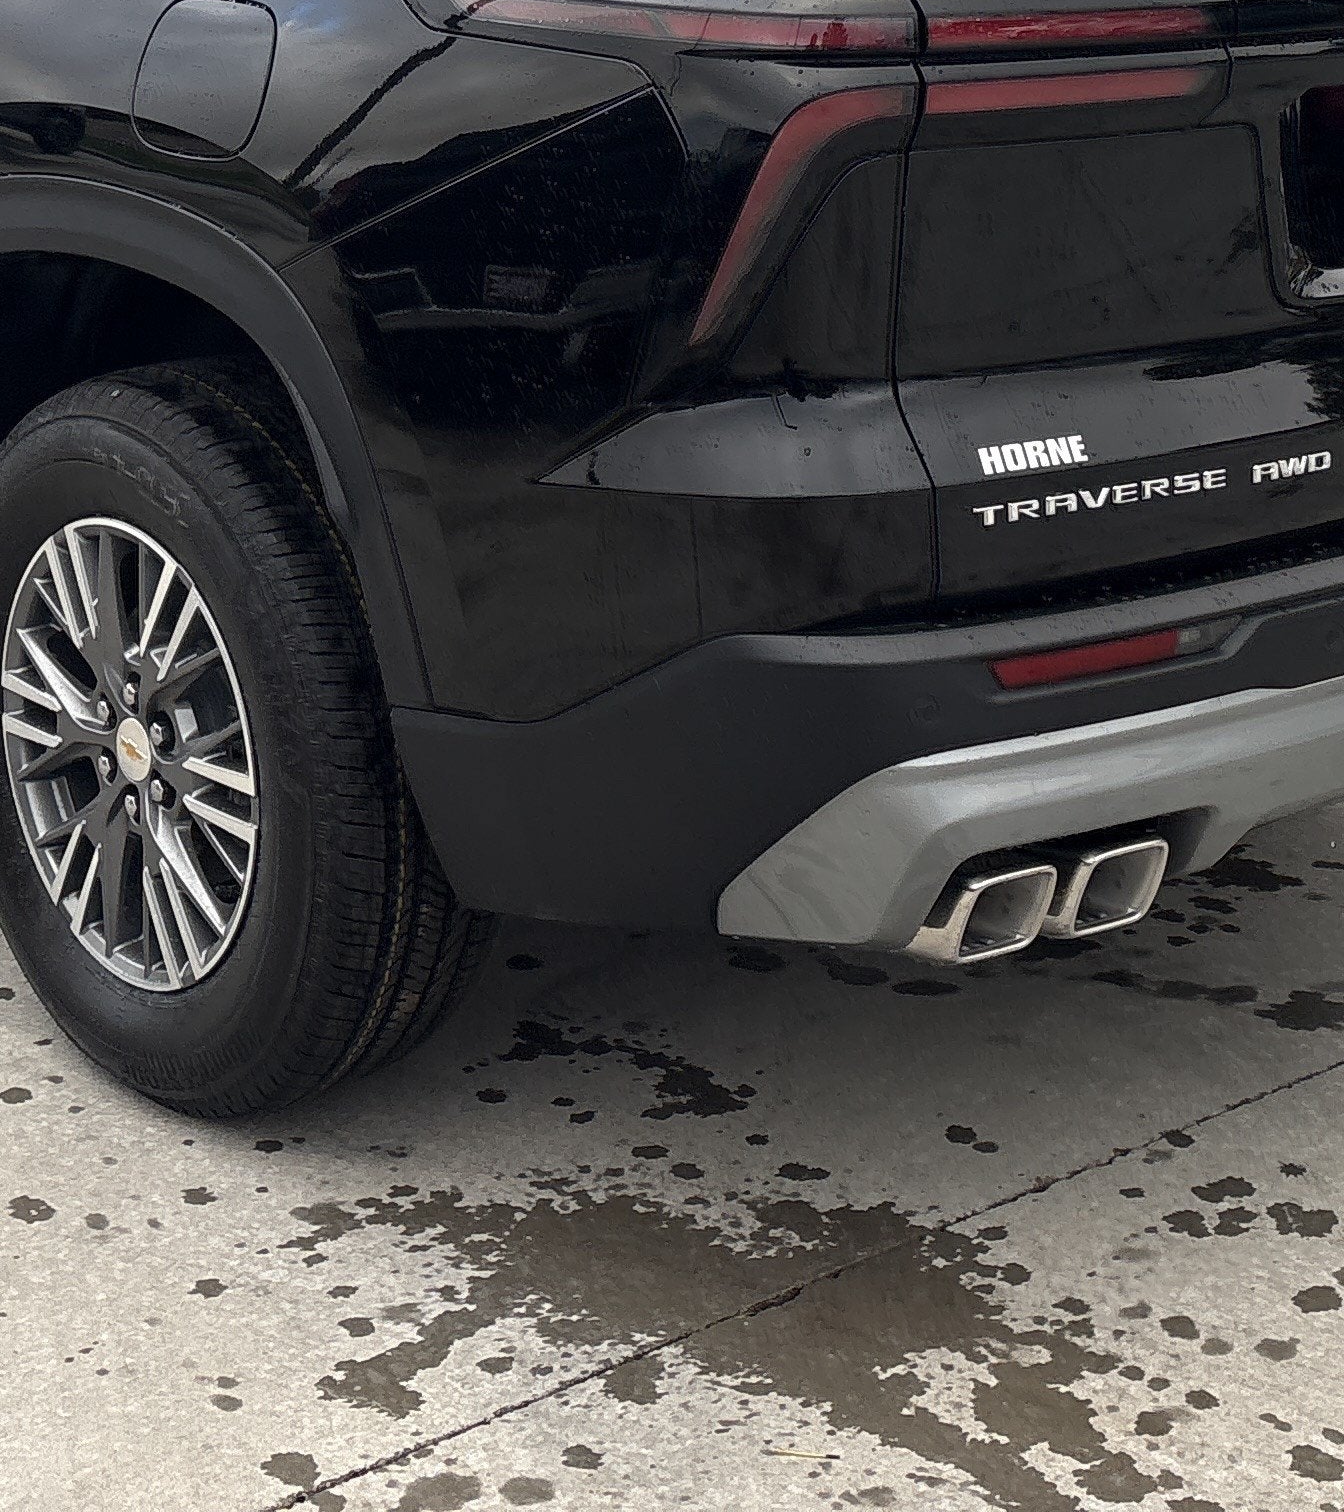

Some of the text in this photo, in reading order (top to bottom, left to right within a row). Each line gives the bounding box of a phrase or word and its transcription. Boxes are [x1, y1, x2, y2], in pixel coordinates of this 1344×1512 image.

[977, 434, 1089, 476] HORNE
[972, 451, 1332, 527] TRAVERSE AWD
